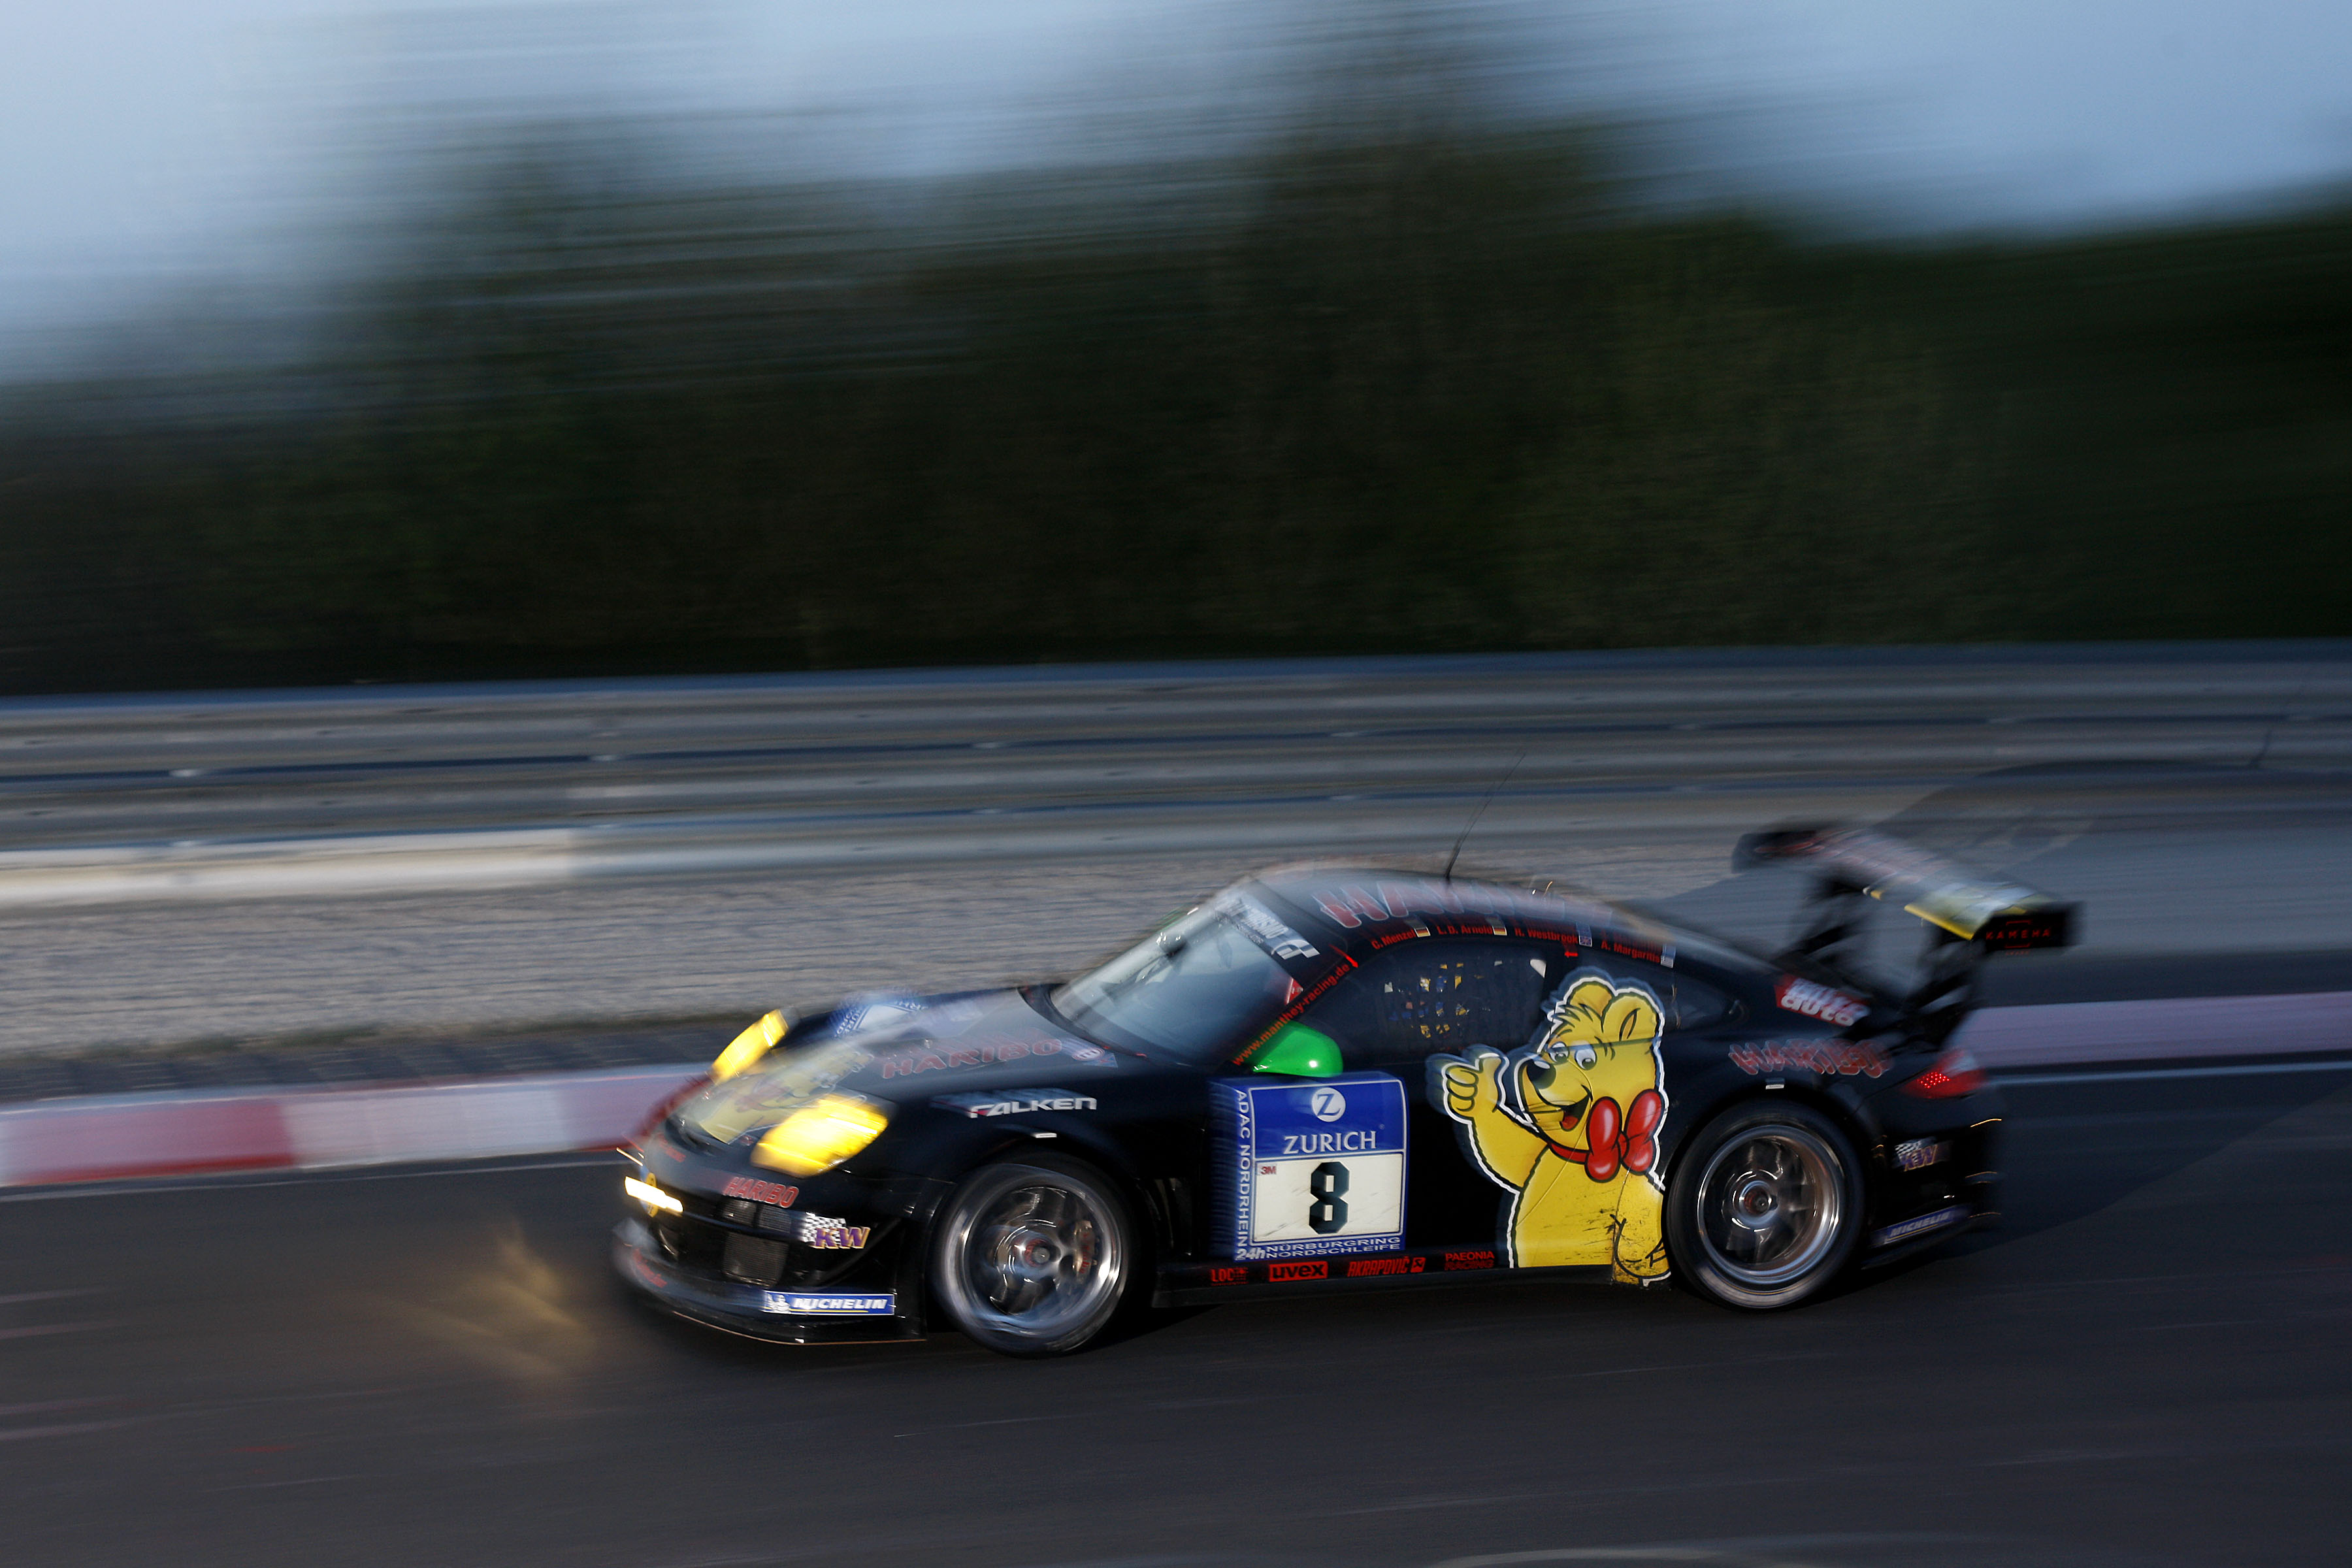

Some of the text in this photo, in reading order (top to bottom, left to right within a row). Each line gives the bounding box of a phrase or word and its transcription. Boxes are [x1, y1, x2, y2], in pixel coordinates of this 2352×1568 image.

[1232, 962, 1350, 1066] www.manthey-racing.de
[882, 1037, 1063, 1079] HARIBO
[967, 1096, 1098, 1119] FALKEN
[1282, 1130, 1377, 1155] ZURICH
[1236, 1090, 1250, 1247] ADAC NORDRHEIN
[1260, 1166, 1277, 1175] 3M
[722, 1177, 800, 1209] HARIBO
[1309, 1161, 1350, 1235] 8
[1889, 1211, 1952, 1237] MICHELIN
[811, 1226, 871, 1249] KW
[1235, 1247, 1266, 1261] 24h
[1266, 1243, 1401, 1259] NORDSCHLEIFE
[1445, 1250, 1495, 1262] PAEONIA
[1273, 1263, 1325, 1279] uvex
[792, 1298, 889, 1310] MICHELIN
